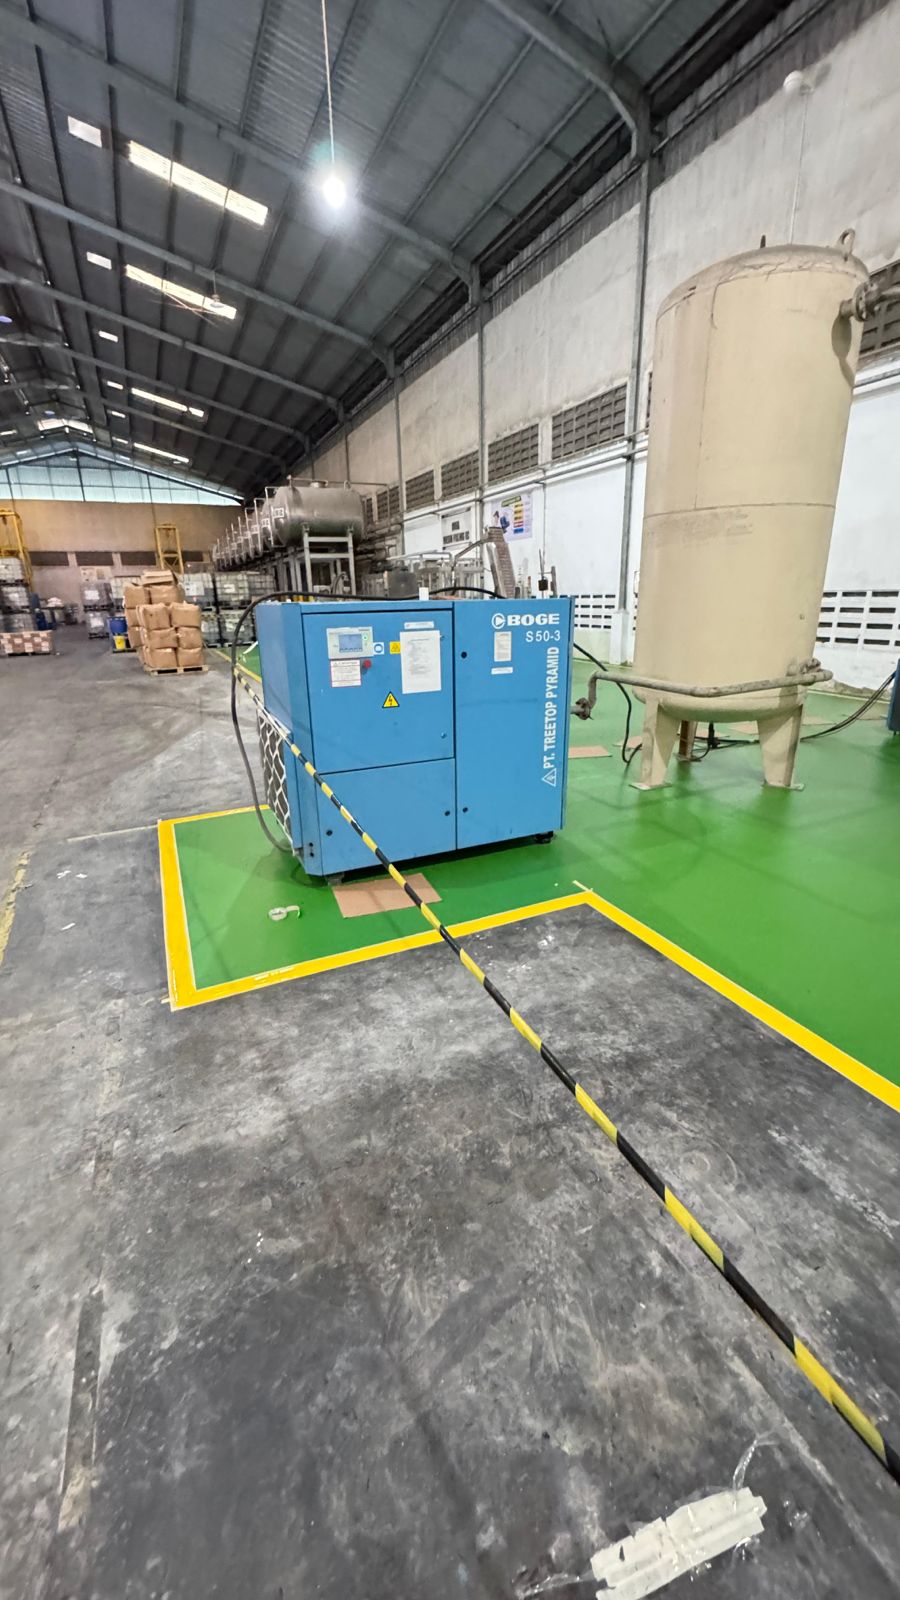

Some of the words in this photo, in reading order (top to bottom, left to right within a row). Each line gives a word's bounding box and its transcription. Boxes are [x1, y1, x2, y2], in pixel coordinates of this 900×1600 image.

[507, 613, 560, 626] BOGE
[545, 646, 560, 699] PYRAMID
[543, 701, 558, 752] TREETOP
[543, 753, 556, 770] PT.
